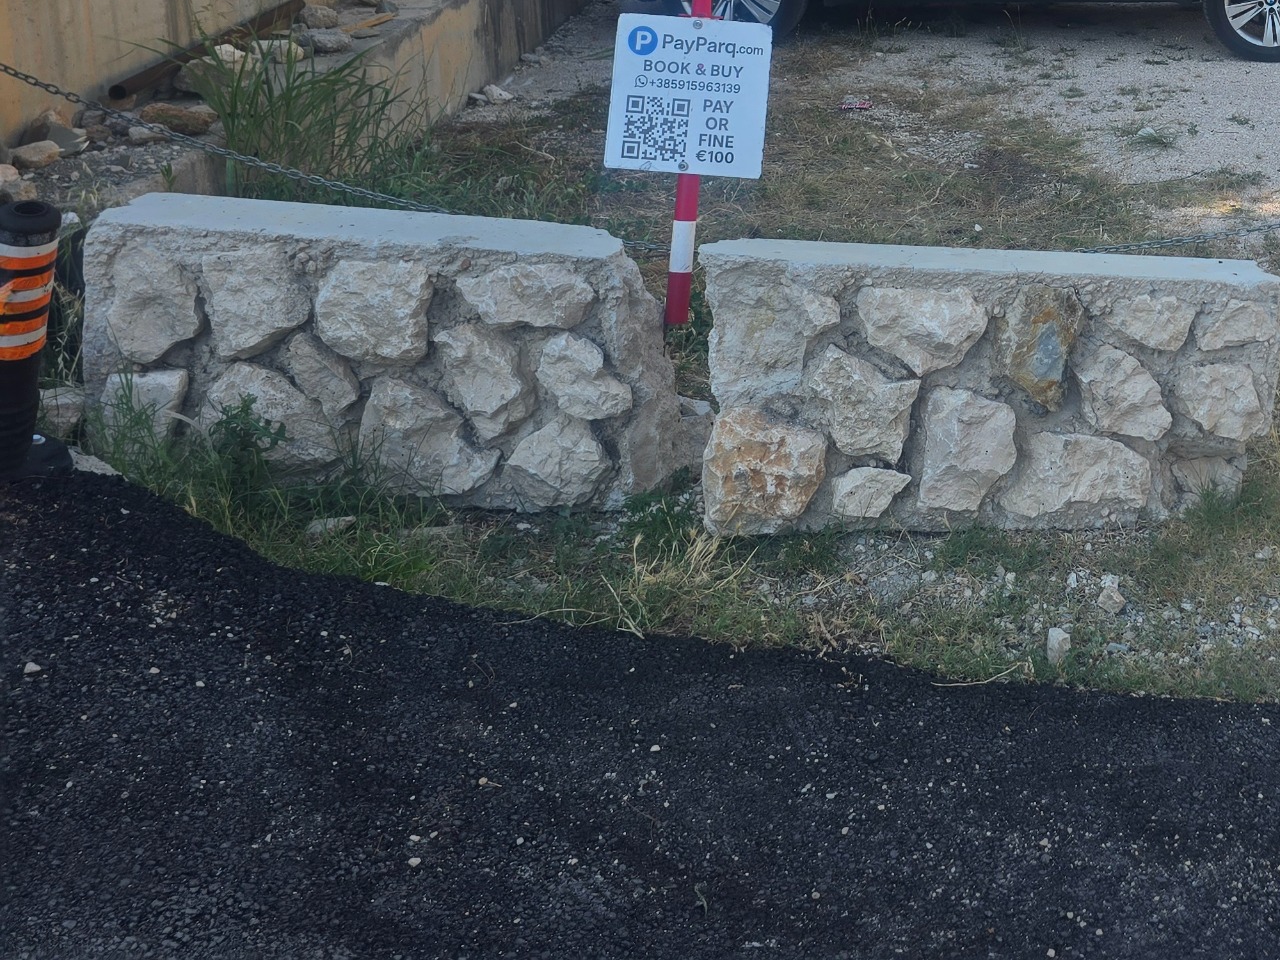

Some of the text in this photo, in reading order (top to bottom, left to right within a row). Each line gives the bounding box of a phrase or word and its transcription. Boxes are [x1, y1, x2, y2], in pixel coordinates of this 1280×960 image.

[635, 30, 764, 58] P PayParq.com
[643, 59, 744, 78] BOOK & BUY
[649, 79, 741, 94] +385915963139
[703, 99, 734, 114] PAY
[705, 117, 729, 131] OR
[699, 133, 734, 148] FINE
[695, 150, 735, 164] €100
